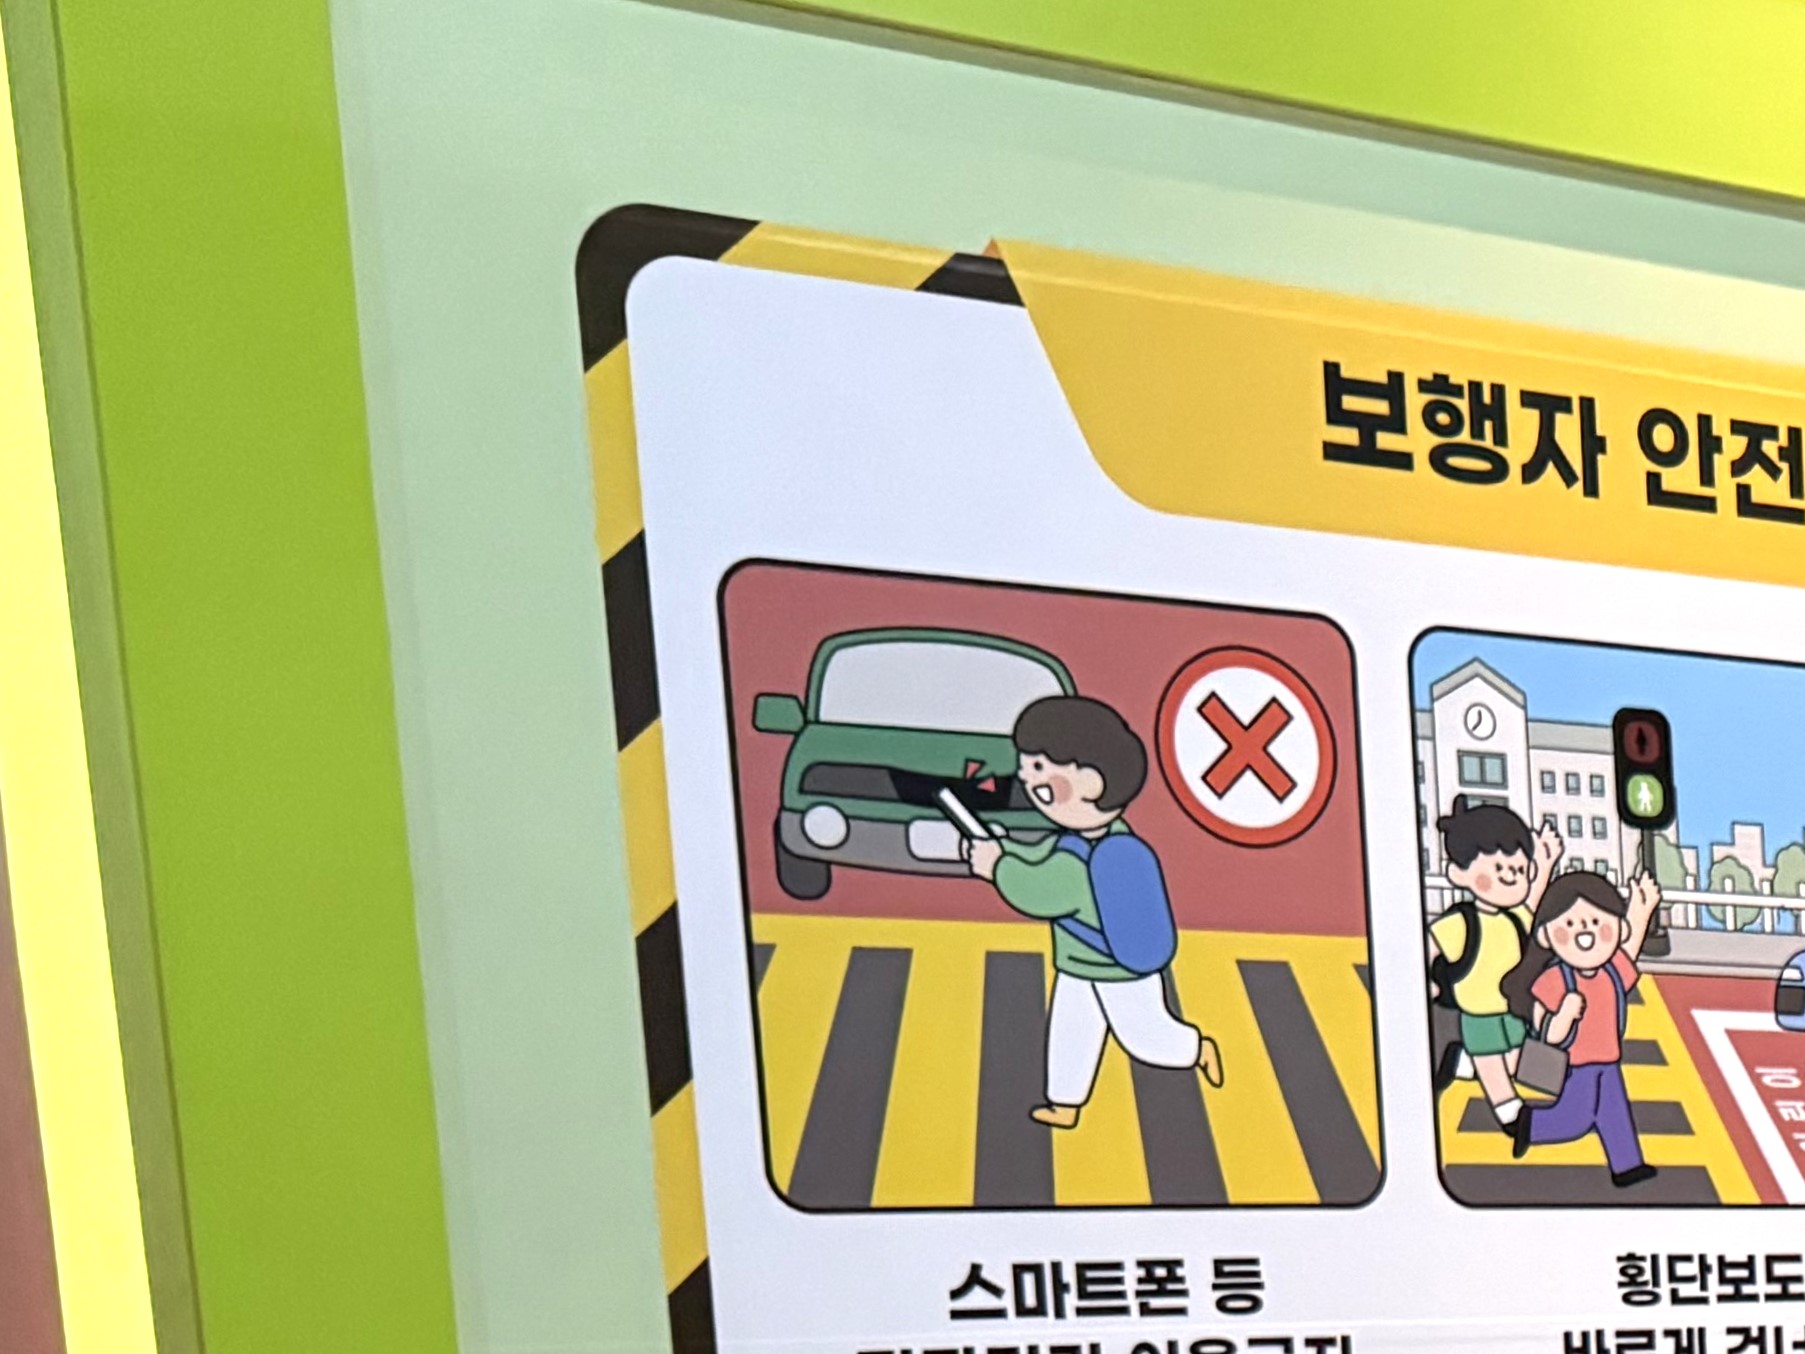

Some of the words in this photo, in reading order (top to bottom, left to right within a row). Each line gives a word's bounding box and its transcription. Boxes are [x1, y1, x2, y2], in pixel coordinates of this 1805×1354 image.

[1321, 360, 1608, 499] 보행자
[948, 1257, 1190, 1320] 스마트폰
[1211, 1256, 1266, 1315] 등
